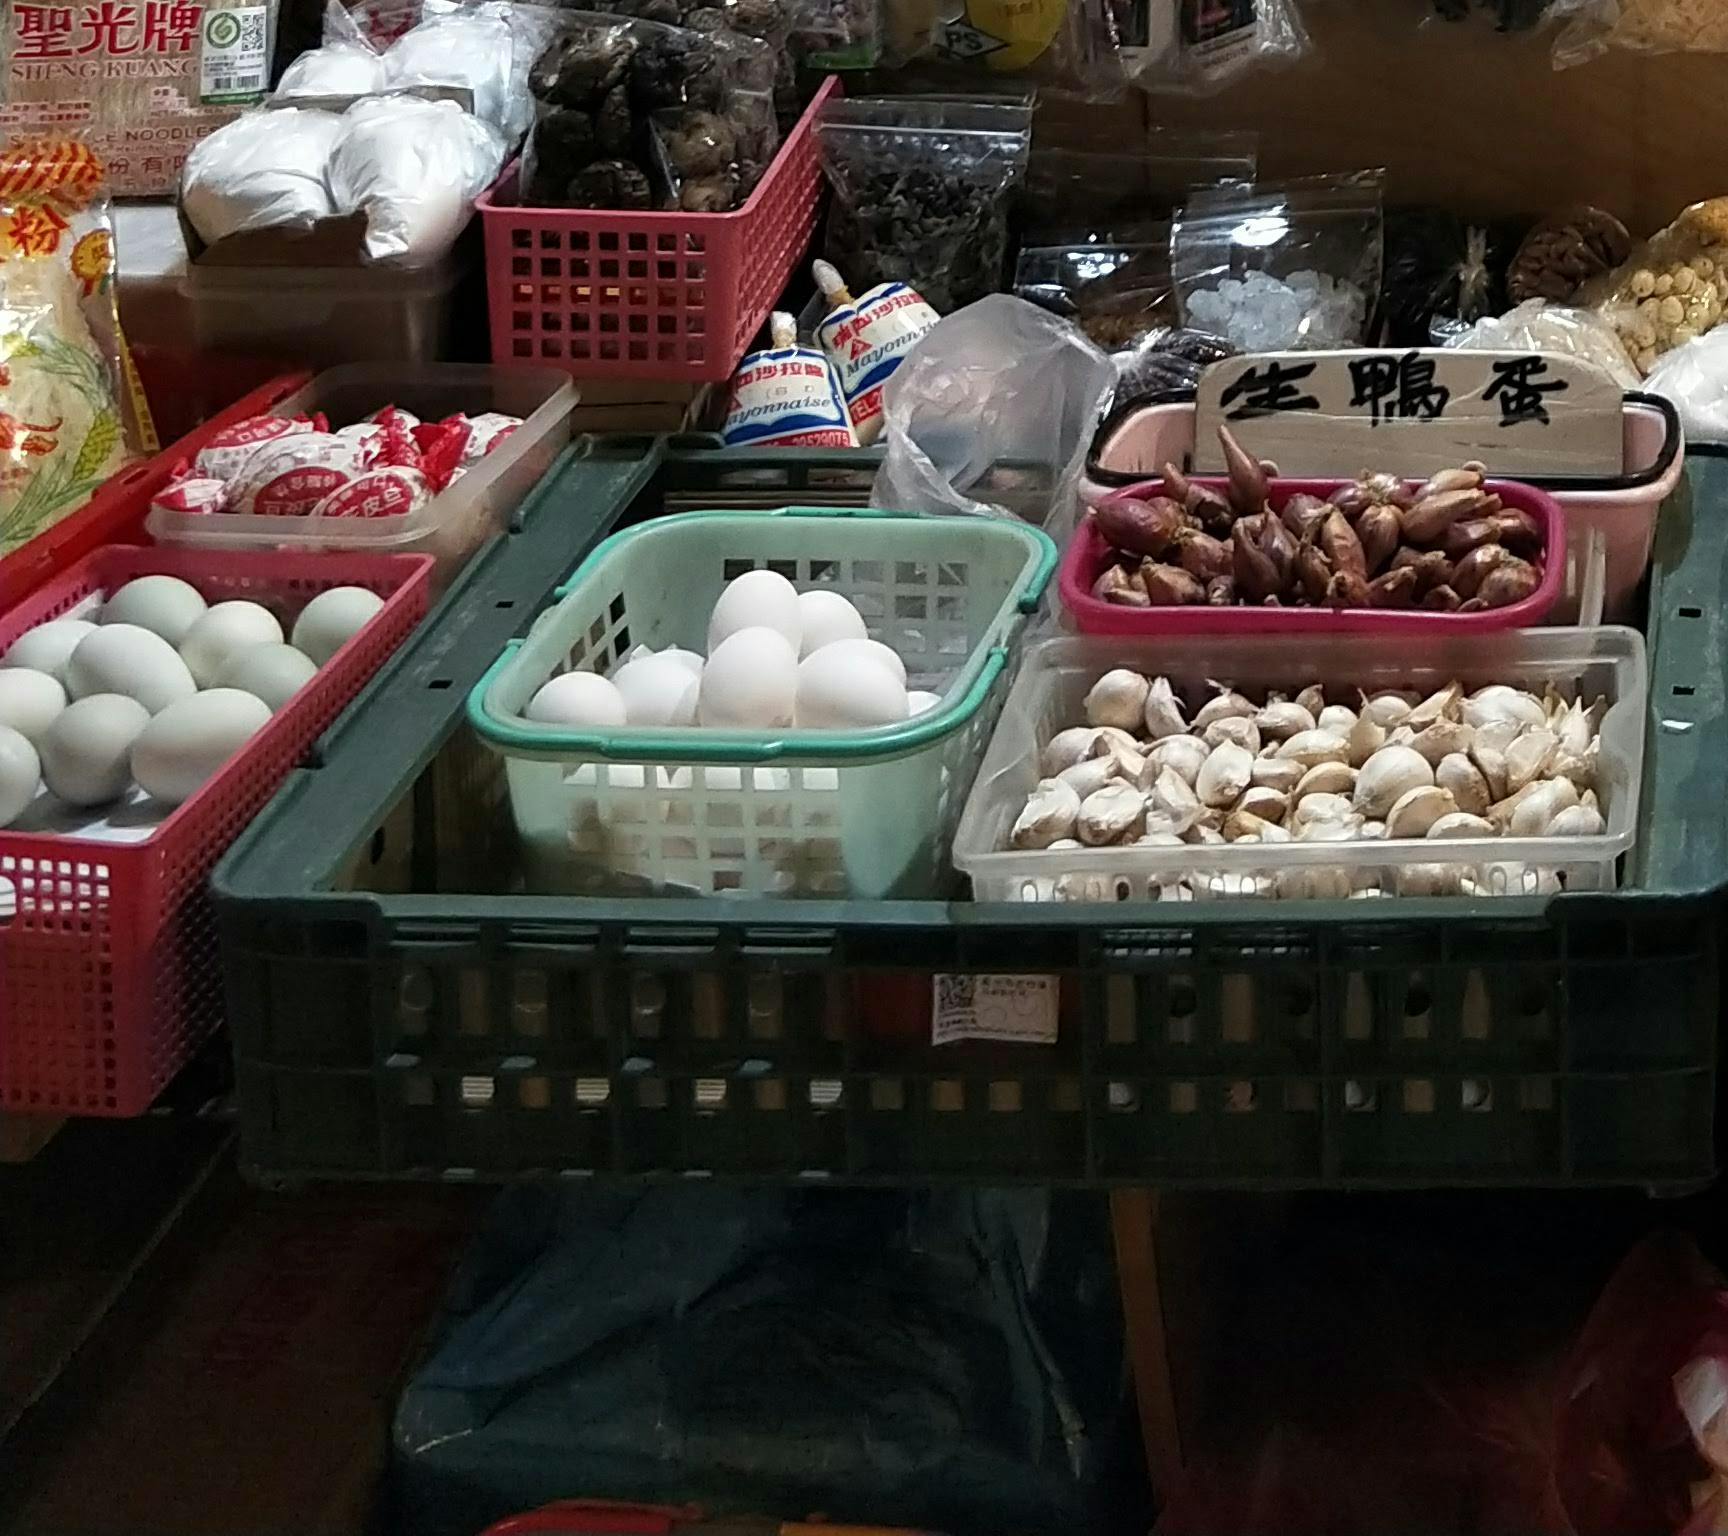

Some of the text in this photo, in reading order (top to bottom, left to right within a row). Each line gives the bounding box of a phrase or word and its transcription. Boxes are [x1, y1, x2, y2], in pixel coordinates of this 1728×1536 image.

[10, 60, 98, 80] SHENG
[106, 59, 200, 79] KUANG
[1217, 353, 1569, 428] 生鴨蛋
[726, 397, 831, 427] ayonnaise
